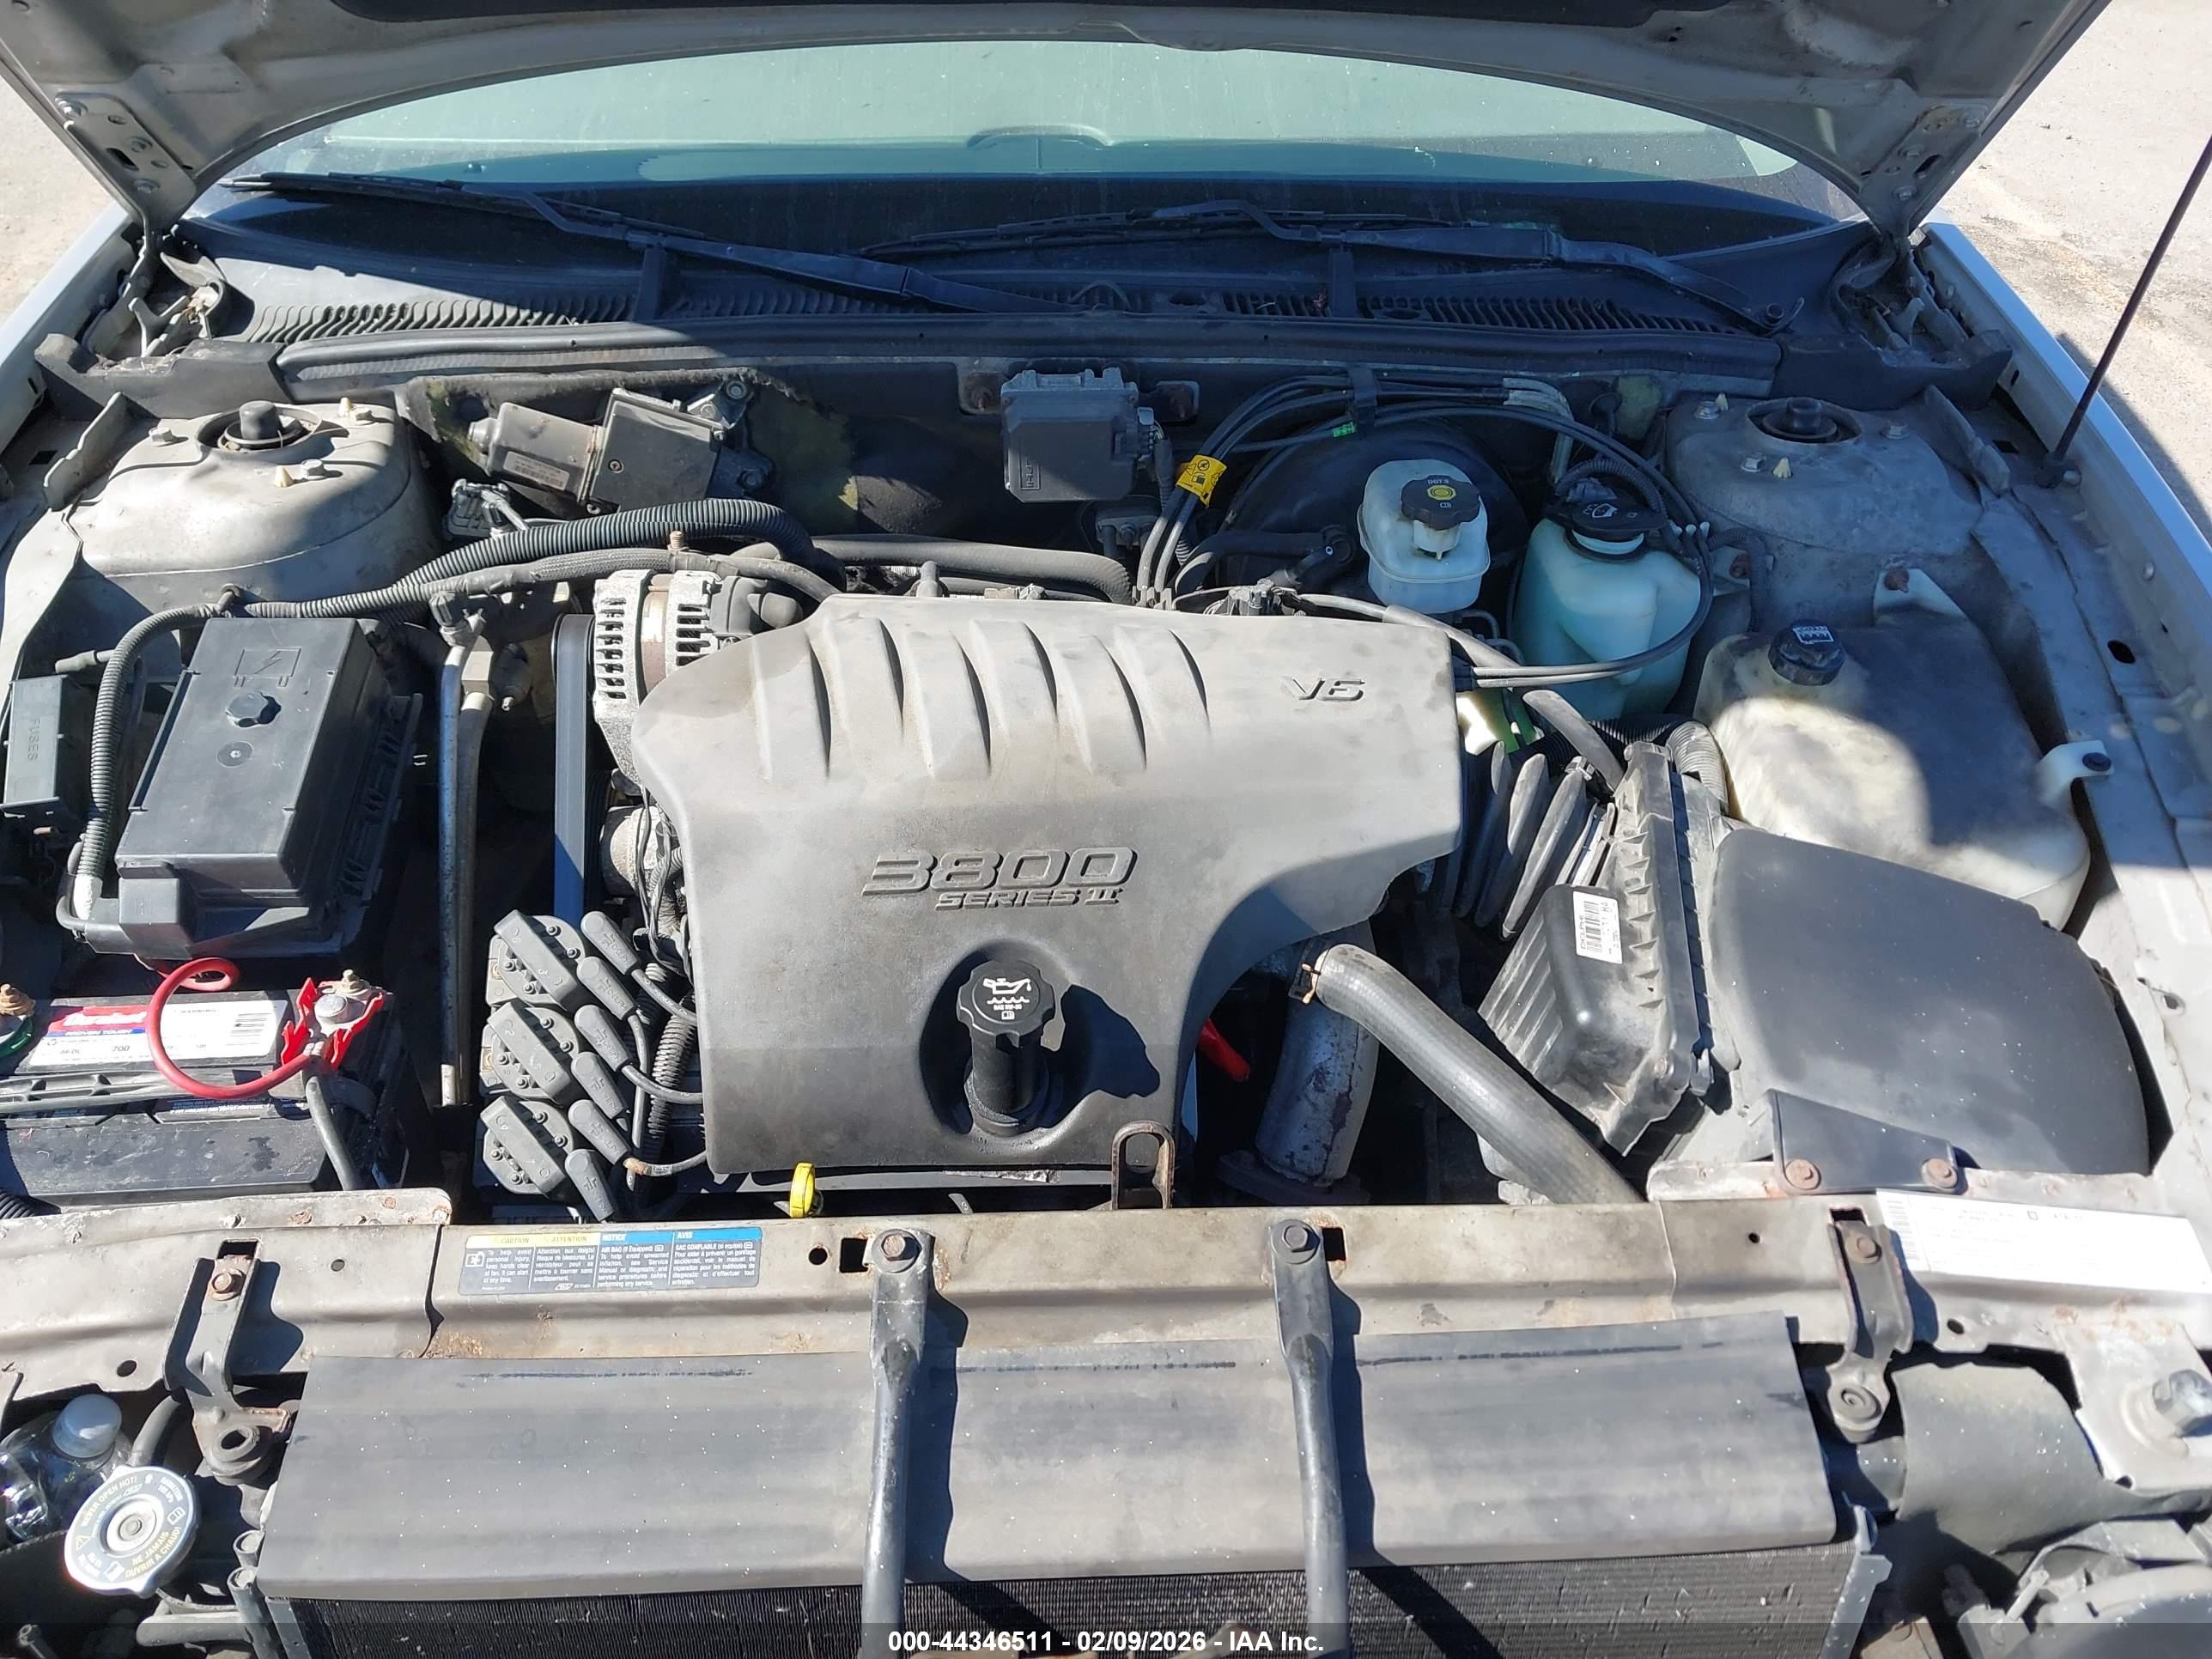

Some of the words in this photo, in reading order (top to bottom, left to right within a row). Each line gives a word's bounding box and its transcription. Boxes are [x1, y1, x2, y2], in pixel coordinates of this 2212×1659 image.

[1281, 676, 1365, 702] V6
[861, 847, 1137, 896] 3800
[935, 889, 1081, 911] SERIES
[1085, 888, 1123, 906] II
[145, 1531, 169, 1559] JAMAIS
